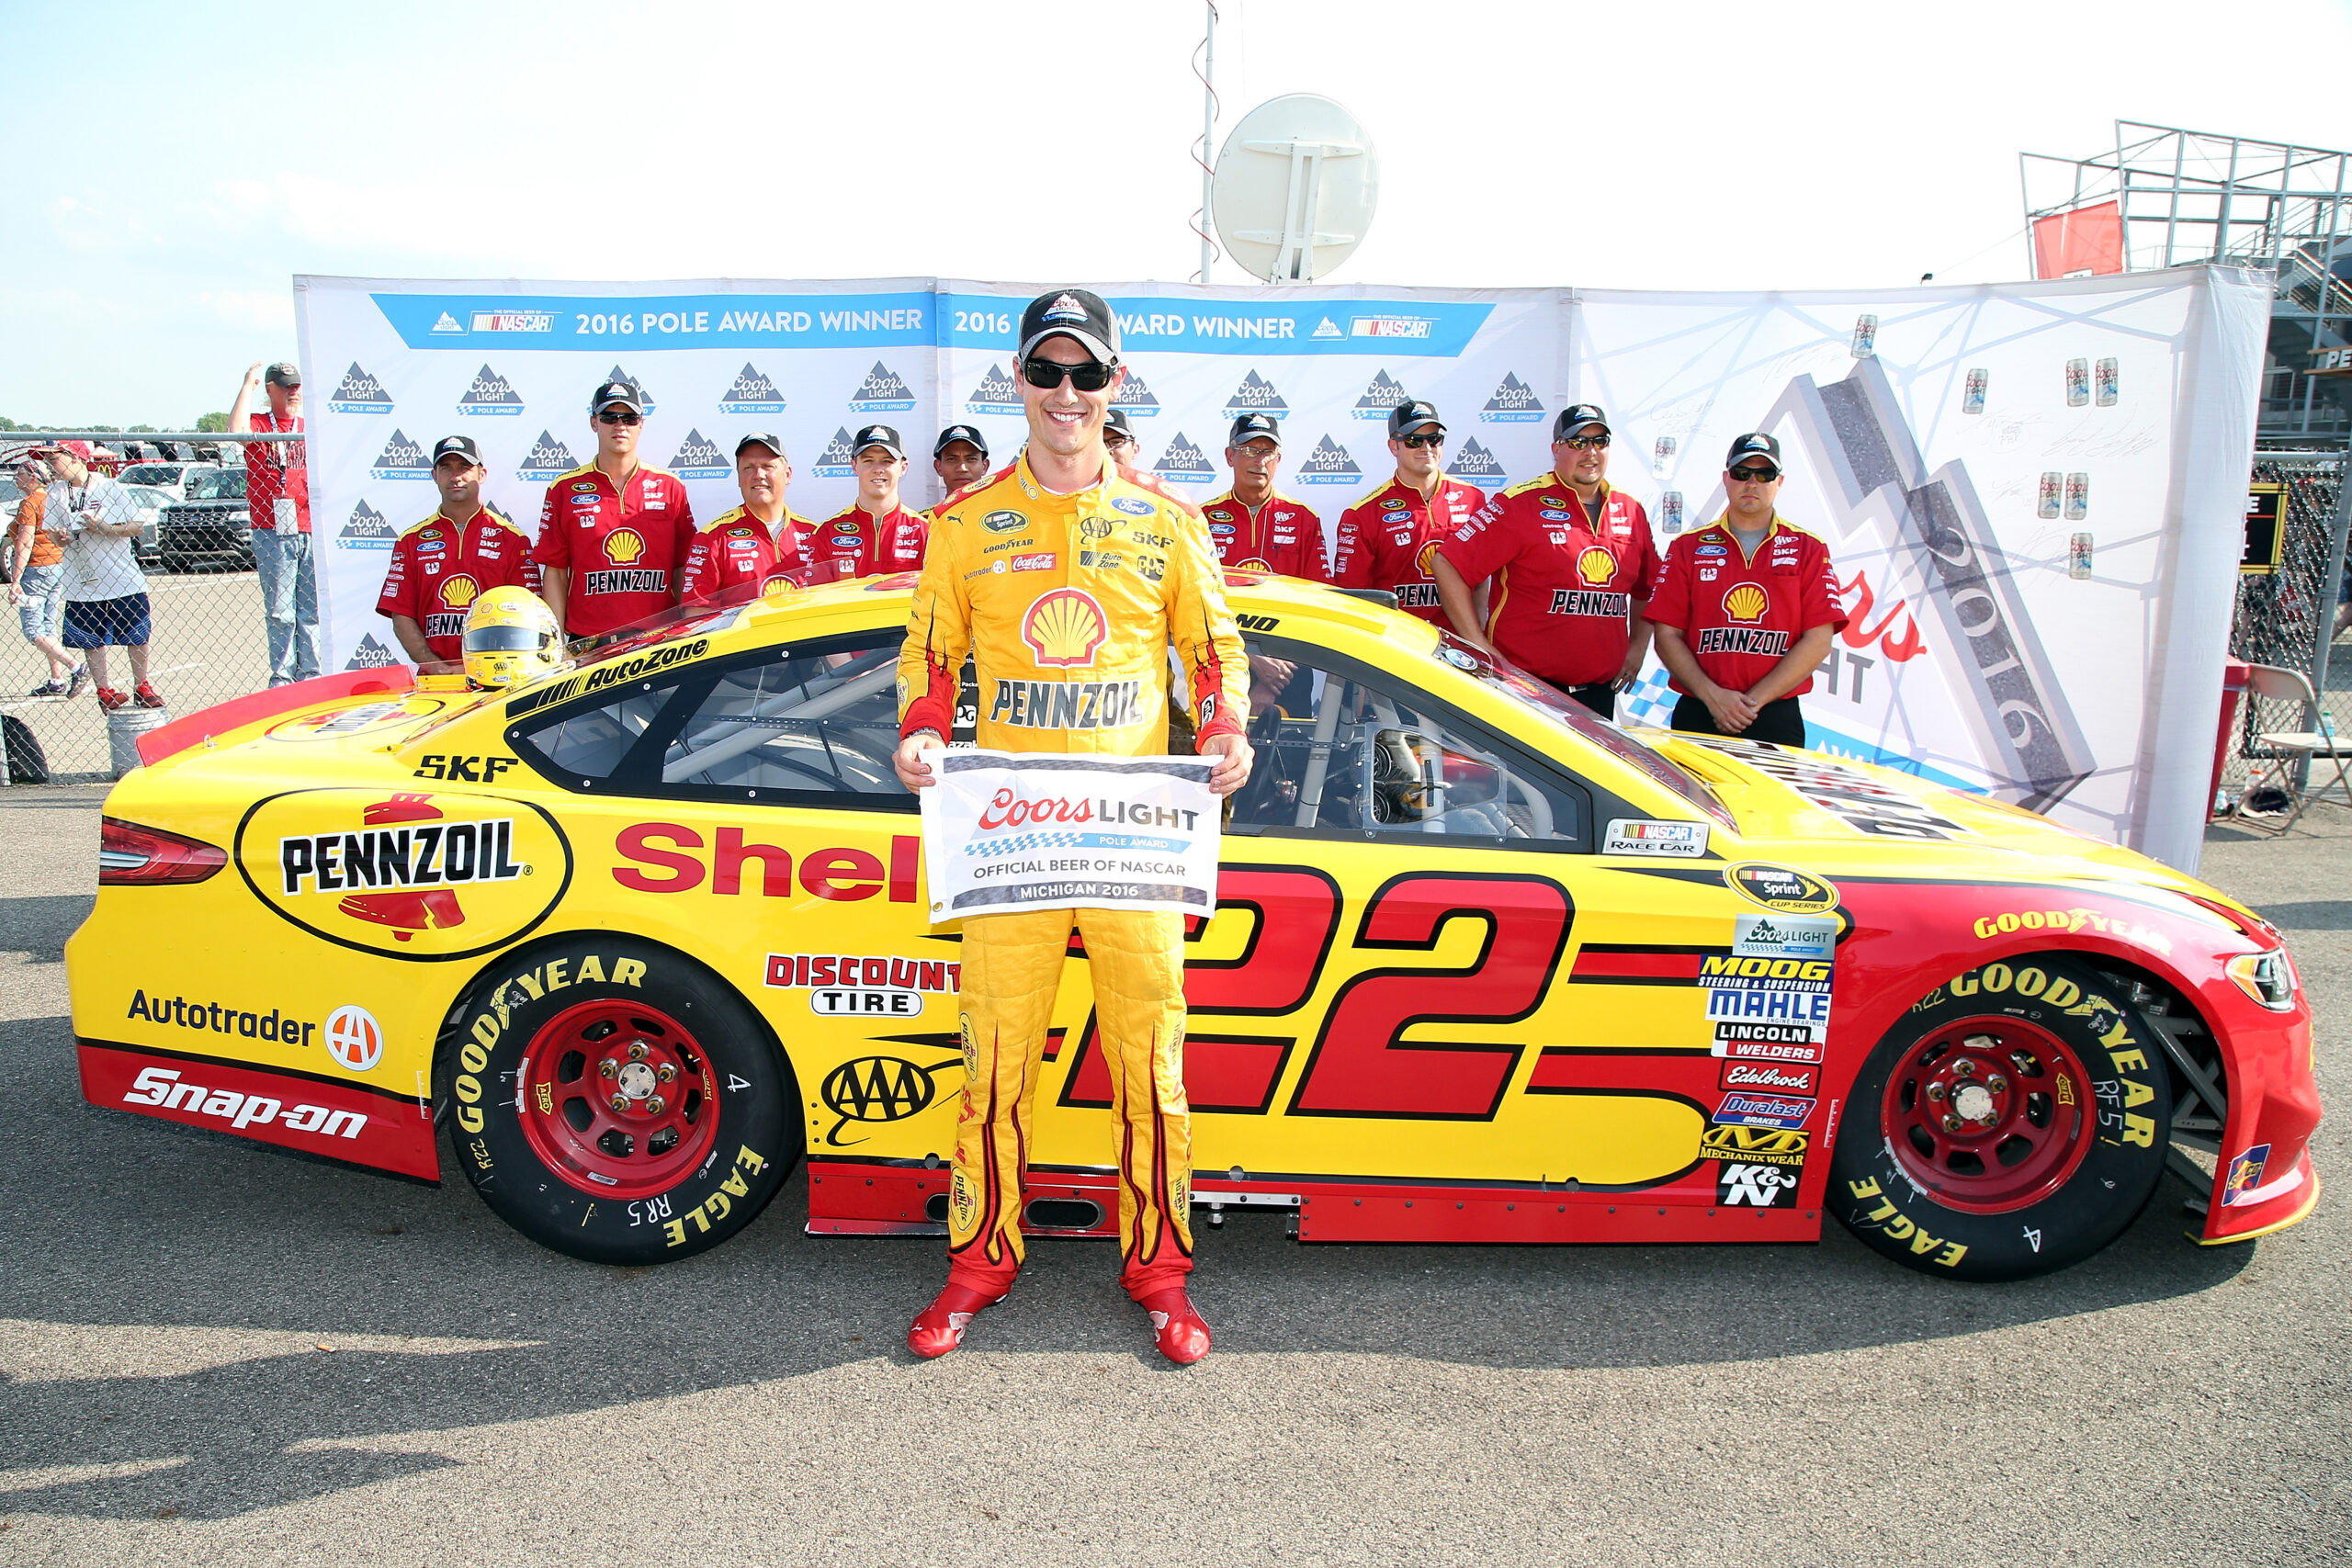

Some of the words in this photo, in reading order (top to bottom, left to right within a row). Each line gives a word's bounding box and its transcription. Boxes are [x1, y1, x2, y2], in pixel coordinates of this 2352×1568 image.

[500, 315, 550, 332] NASCAR
[576, 313, 635, 334] 2016
[642, 311, 709, 333] POLE
[718, 310, 812, 333] AWARD
[820, 309, 923, 332] WINNER
[955, 311, 1012, 333] 2016
[1116, 314, 1185, 336] WARD
[1193, 315, 1295, 339] WINNER
[1378, 320, 1429, 338] NASCAR
[2325, 348, 2352, 369] PE
[338, 374, 383, 391] Coors
[469, 376, 514, 393] Coors
[732, 375, 777, 392] Coors
[863, 373, 907, 390] Coors
[979, 375, 1015, 392] Coor
[1237, 380, 1281, 399] Coors
[346, 390, 375, 400] LIGHT
[477, 393, 505, 402] LIGHT
[739, 391, 766, 400] LIGHT
[868, 389, 897, 399] LIGHT
[985, 392, 1013, 401] LIGHT
[1242, 397, 1270, 406] LIGHT
[1494, 384, 1538, 401] Coors
[478, 407, 494, 415] POLE
[496, 407, 518, 415] AWARD
[757, 404, 779, 412] AWARD
[1499, 399, 1527, 408] LIGHT
[381, 441, 426, 458] Coors
[678, 440, 722, 458] Coors
[1163, 444, 1208, 462] Coors
[1310, 446, 1354, 464] Coors
[390, 457, 417, 467] LIGHT
[684, 457, 713, 465] LIGHT
[1169, 459, 1198, 468] LIGHT
[1316, 462, 1344, 471] LIGHT
[1187, 474, 1210, 482] AWARD
[1117, 499, 1148, 515] Ford
[345, 511, 390, 529] Coors
[996, 518, 1013, 529] Sprint
[1081, 517, 1112, 538] AAA
[355, 527, 382, 536] LIGHT
[1132, 530, 1175, 549] SKF
[983, 538, 1034, 554] GOODYEAR
[1012, 554, 1056, 571] Coca-Cola
[1098, 560, 1120, 570] Zone
[1102, 553, 1122, 562] Auto
[584, 569, 668, 596] PENNZOIL
[1394, 583, 1442, 608] PENN
[1547, 589, 1628, 618] PENNZOIL
[425, 614, 464, 637] PENN
[1236, 613, 1281, 632] NO
[1696, 627, 1790, 657] PENNZOIL
[1927, 526, 2054, 750] 2016
[584, 638, 709, 691] AutoZone
[989, 678, 1146, 729] PENNZOIL
[413, 754, 519, 784] SKF
[978, 787, 1094, 830] Coors
[1099, 798, 1199, 831] LIGHT
[1642, 824, 1692, 841] NASCAR
[1099, 836, 1126, 847] POLE
[1130, 837, 1169, 850] AWARD
[1611, 840, 1656, 851] RACE
[1656, 842, 1695, 852] CAR
[282, 817, 524, 896] PENNZOIL
[612, 821, 920, 904] Shel
[973, 860, 1046, 880] OFFICIAL
[1049, 859, 1090, 873] BEER
[1093, 860, 1116, 873] OF
[1121, 861, 1186, 876] NASCAR
[1756, 870, 1795, 883] NASCAR
[1020, 885, 1097, 899] MICHIGAN
[1102, 884, 1139, 897] 2016
[1764, 882, 1802, 897] Sprint
[1770, 900, 1790, 908] CUP
[1791, 901, 1826, 910] SERIES
[1745, 922, 1791, 942] Coors
[1792, 931, 1828, 943] LIGHT
[1973, 907, 2174, 957] GOODYEAR
[765, 954, 961, 993] DISCOUNT
[1701, 955, 1833, 981] MOOG
[1059, 862, 1576, 1122] 22
[1699, 976, 1749, 989] STEERING
[1751, 978, 1759, 988] &
[1763, 978, 1831, 993] SUSPENSION
[822, 992, 910, 1013] TIRE
[1709, 989, 1829, 1021] MAHLE
[127, 988, 316, 1047] Autotrader
[1719, 1023, 1807, 1043] LINCOLN
[455, 954, 648, 1134] GOODYEAR
[962, 1022, 976, 1077] PENNZOIL
[1736, 1043, 1816, 1060] WELDERS
[1950, 963, 2155, 1149] GOODYEAR
[728, 1072, 752, 1093] 4
[1726, 1066, 1809, 1090] Edelbrock
[831, 1056, 926, 1122] AAA
[122, 1066, 368, 1140] Snap-on
[537, 1086, 550, 1111] AERO
[1726, 1097, 1807, 1117] Duralast
[1742, 1115, 1782, 1126] BRAKES
[1699, 1145, 1766, 1163] MECHANIX
[1766, 1153, 1804, 1166] WEAR
[662, 1144, 765, 1249] EAGLE
[956, 1174, 967, 1223] PENNZOIL
[1848, 1175, 1969, 1269] EAGLE
[2022, 1224, 2041, 1254] 4
